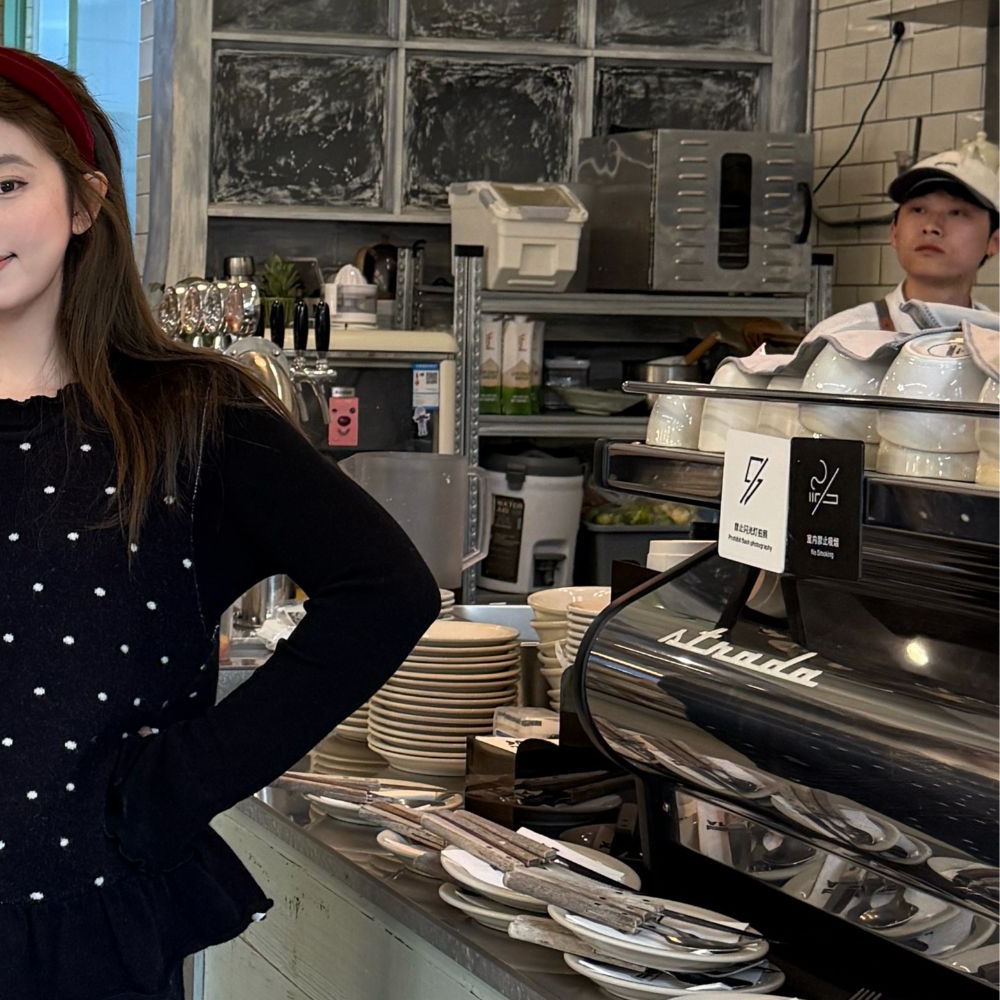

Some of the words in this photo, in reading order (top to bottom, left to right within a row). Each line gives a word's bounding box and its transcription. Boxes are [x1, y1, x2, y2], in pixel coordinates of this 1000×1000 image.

[749, 541, 772, 552] photography
[810, 548, 817, 556] No
[817, 549, 834, 559] Smoking
[657, 627, 823, 688] strada
